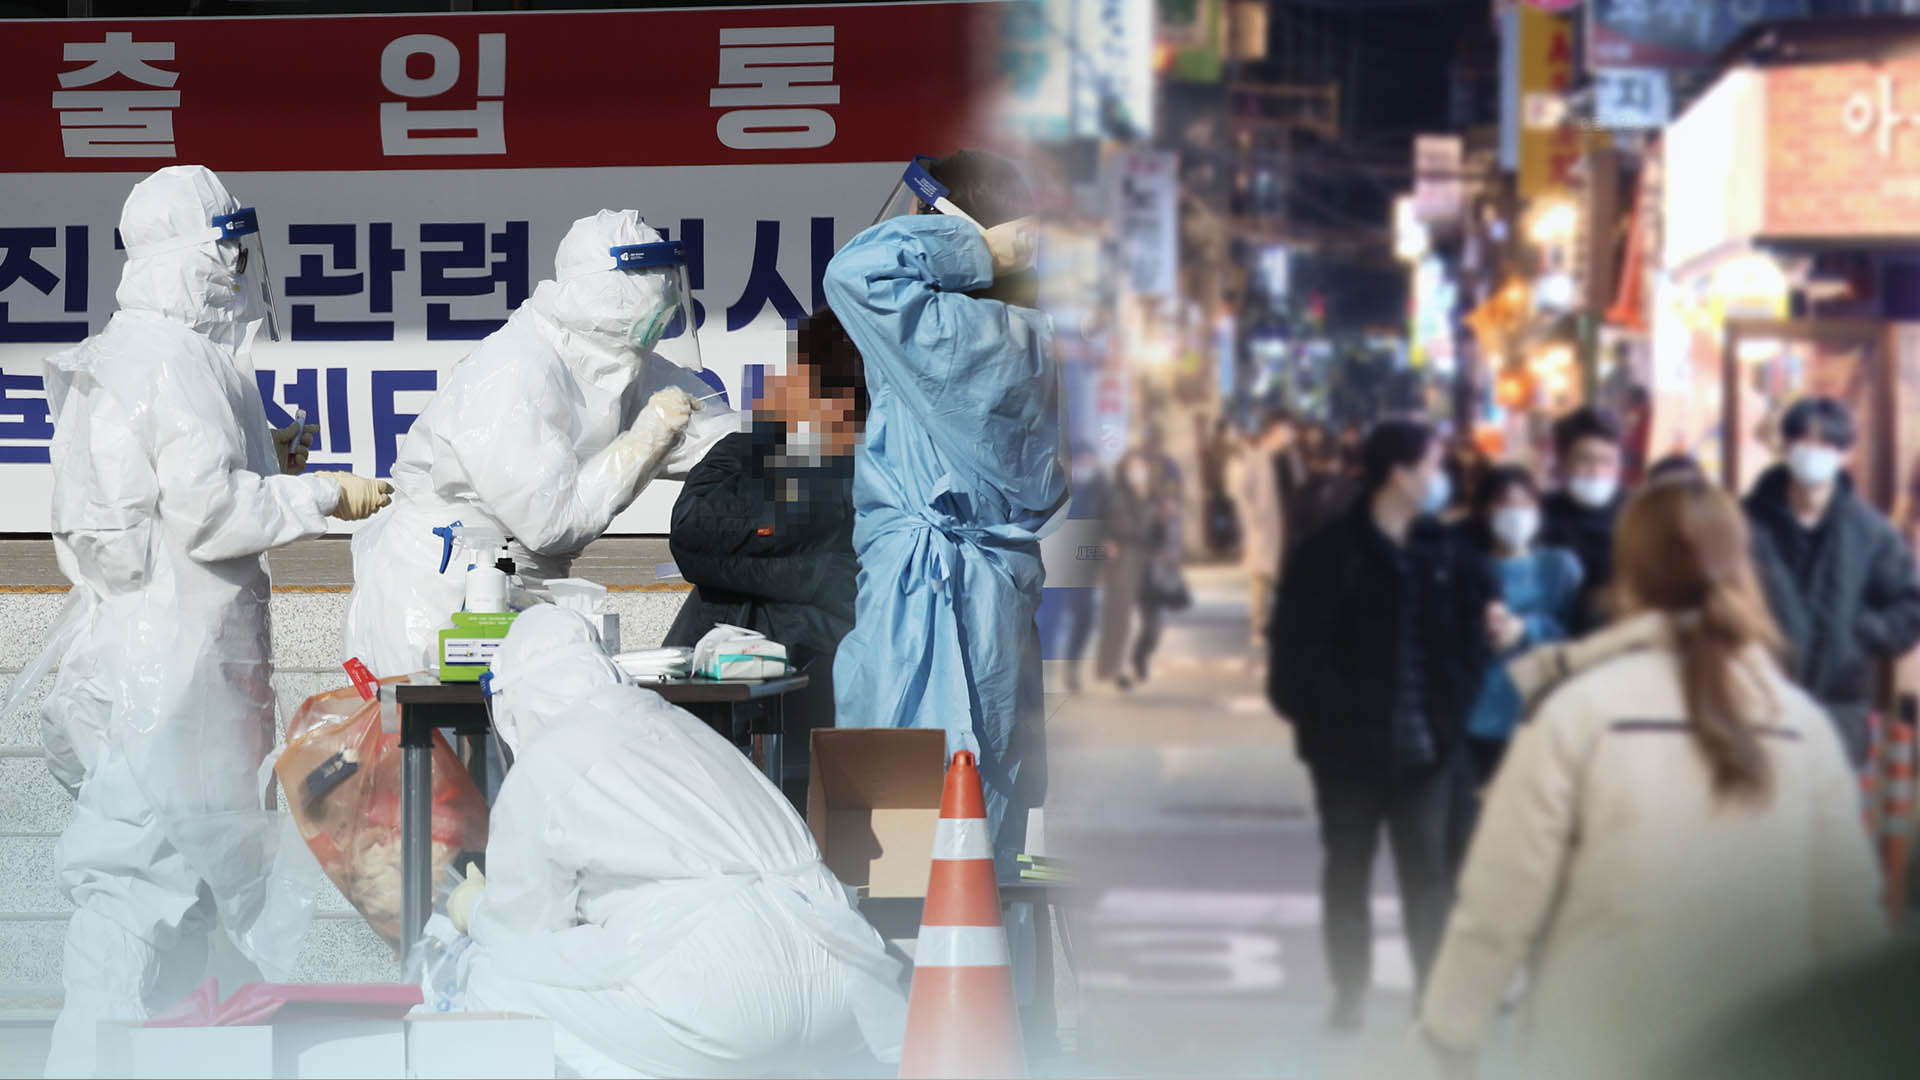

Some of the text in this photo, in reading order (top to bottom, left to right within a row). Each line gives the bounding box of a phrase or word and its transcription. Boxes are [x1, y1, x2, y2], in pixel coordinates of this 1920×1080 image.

[52, 25, 841, 158] 출 입 통
[1842, 75, 1920, 158] 아
[284, 220, 530, 342] 관련
